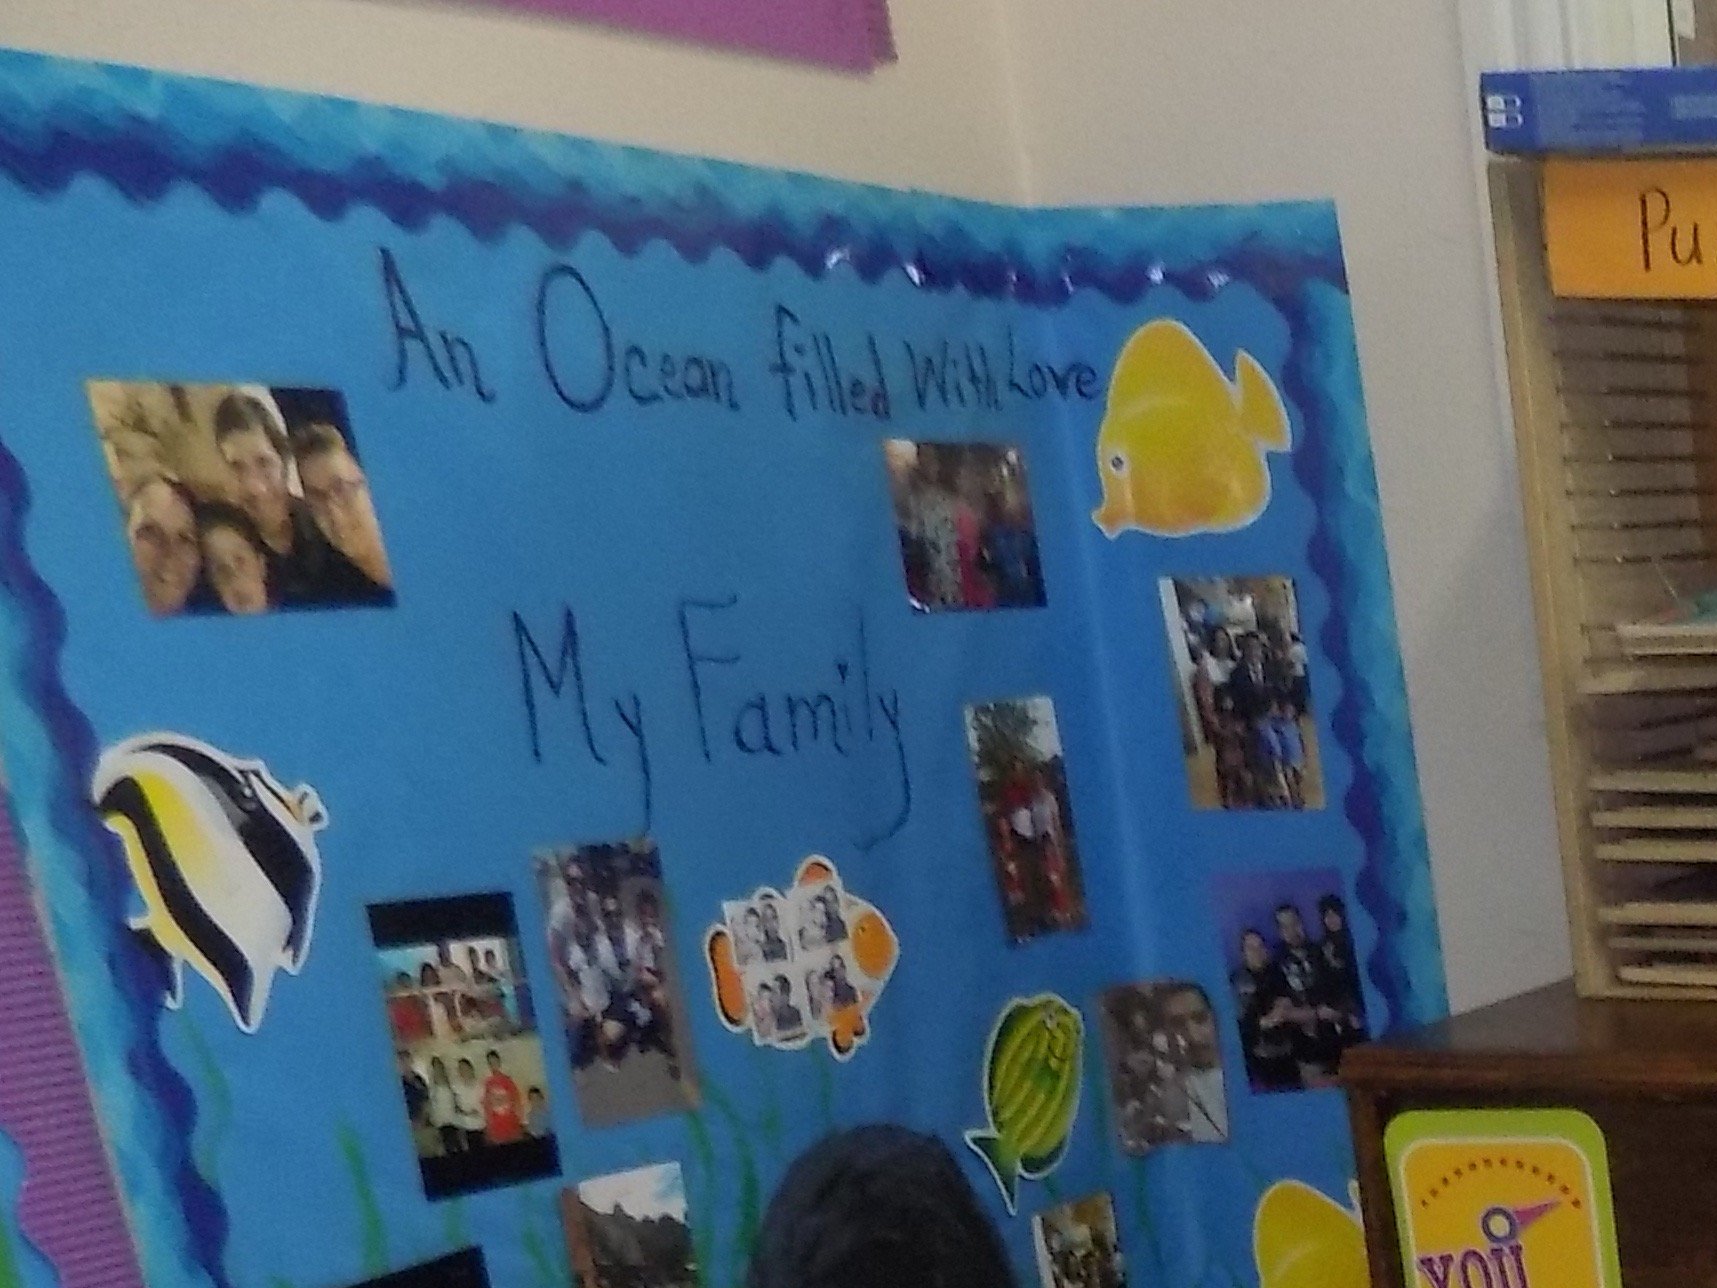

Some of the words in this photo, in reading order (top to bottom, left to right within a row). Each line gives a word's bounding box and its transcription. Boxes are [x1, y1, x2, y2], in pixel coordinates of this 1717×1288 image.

[378, 245, 495, 403] An
[535, 264, 739, 413] Ocean
[1007, 331, 1101, 402] Love
[511, 603, 653, 834] My
[676, 594, 912, 853] Family
